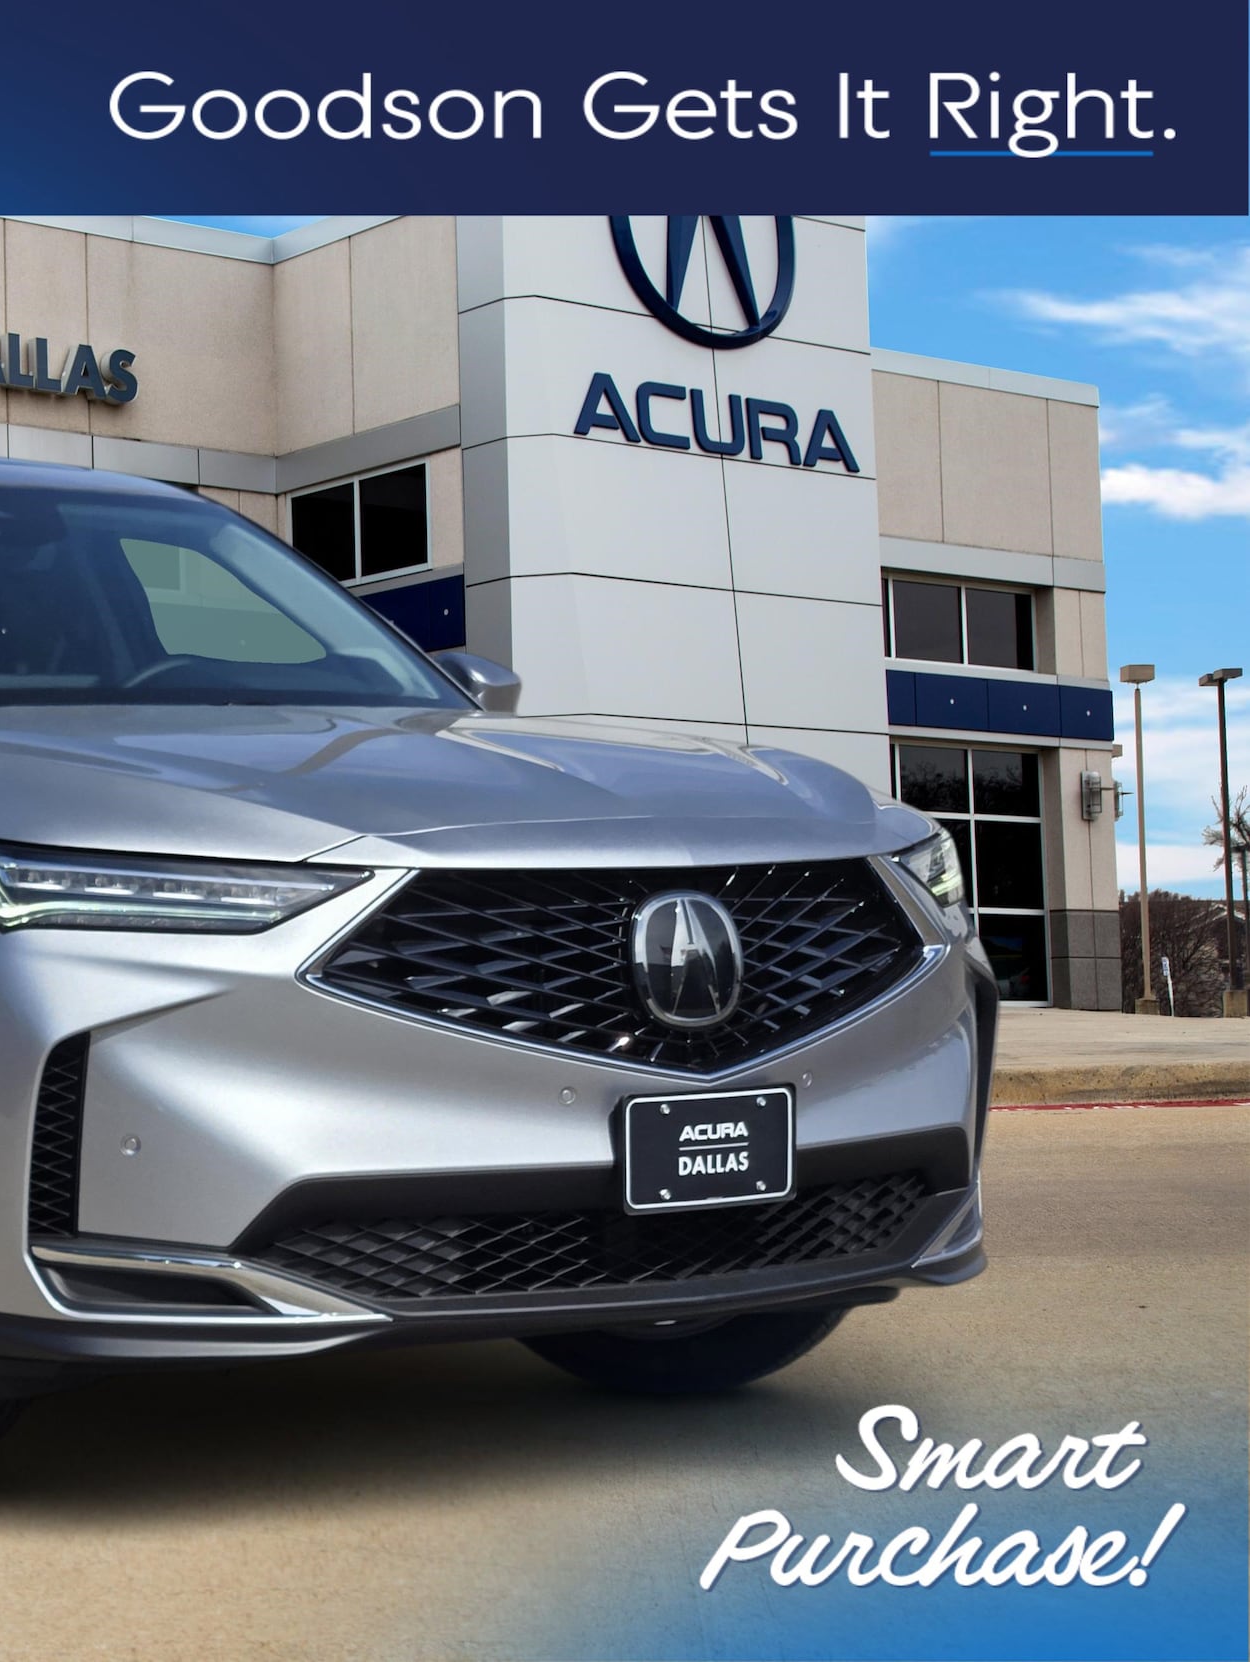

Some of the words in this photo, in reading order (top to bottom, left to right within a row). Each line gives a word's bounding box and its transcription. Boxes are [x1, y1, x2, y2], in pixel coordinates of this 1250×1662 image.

[573, 371, 860, 473] ACURA
[678, 1121, 749, 1142] ACURA
[678, 1151, 749, 1177] DALLAS
